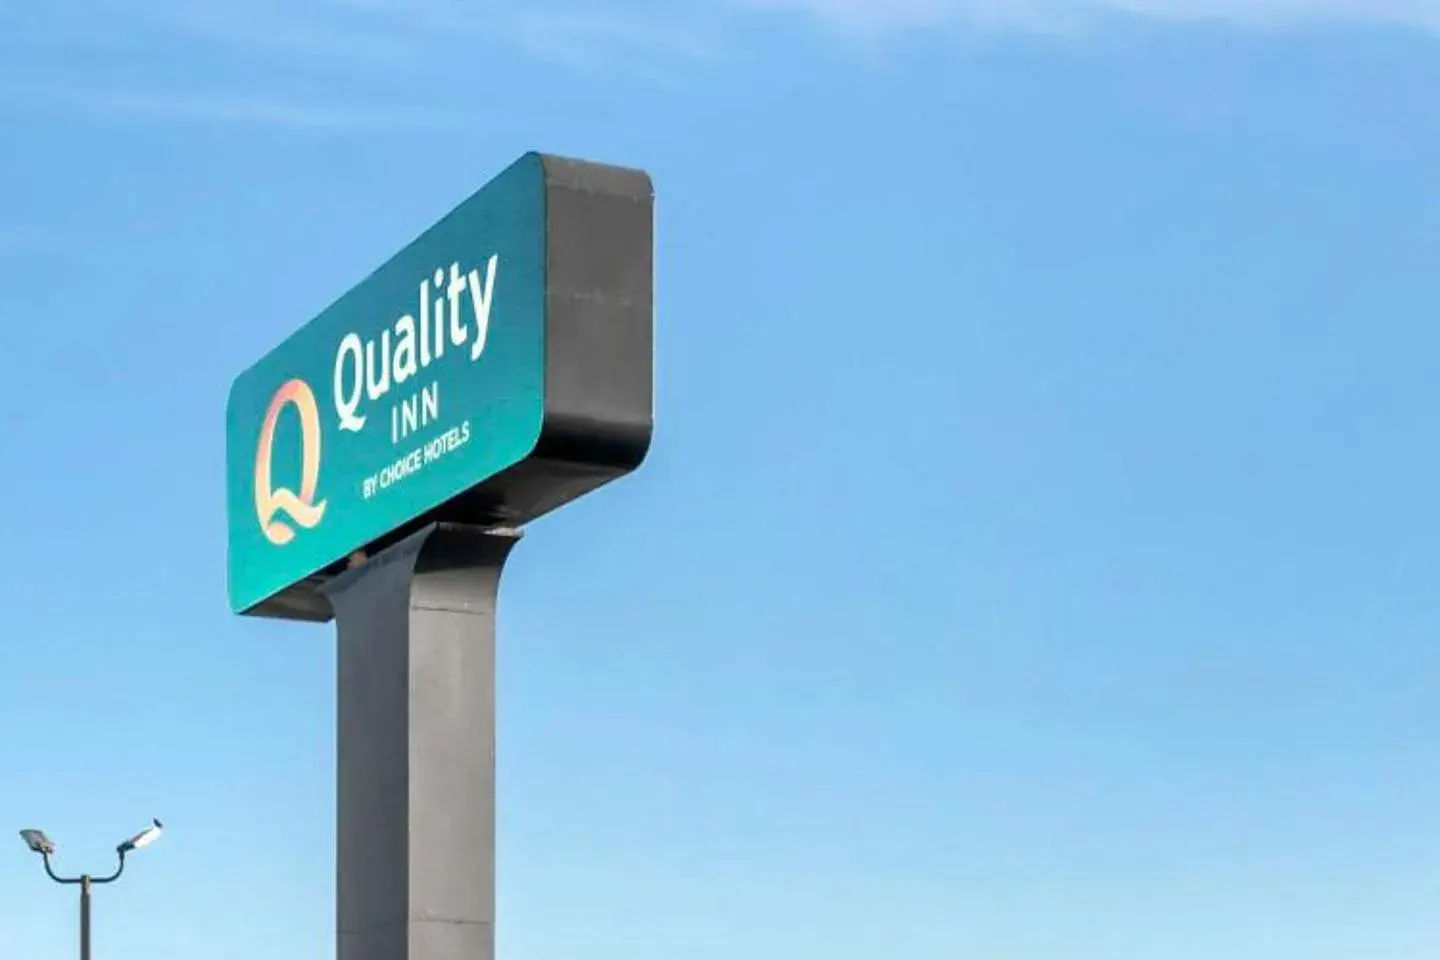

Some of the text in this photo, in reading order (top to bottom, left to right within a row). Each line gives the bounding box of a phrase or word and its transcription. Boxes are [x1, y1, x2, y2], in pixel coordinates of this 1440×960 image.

[334, 254, 498, 432] Quality
[254, 379, 327, 545] Q
[363, 420, 470, 499] BY CHOICE HOTELS
[392, 381, 439, 444] INN
